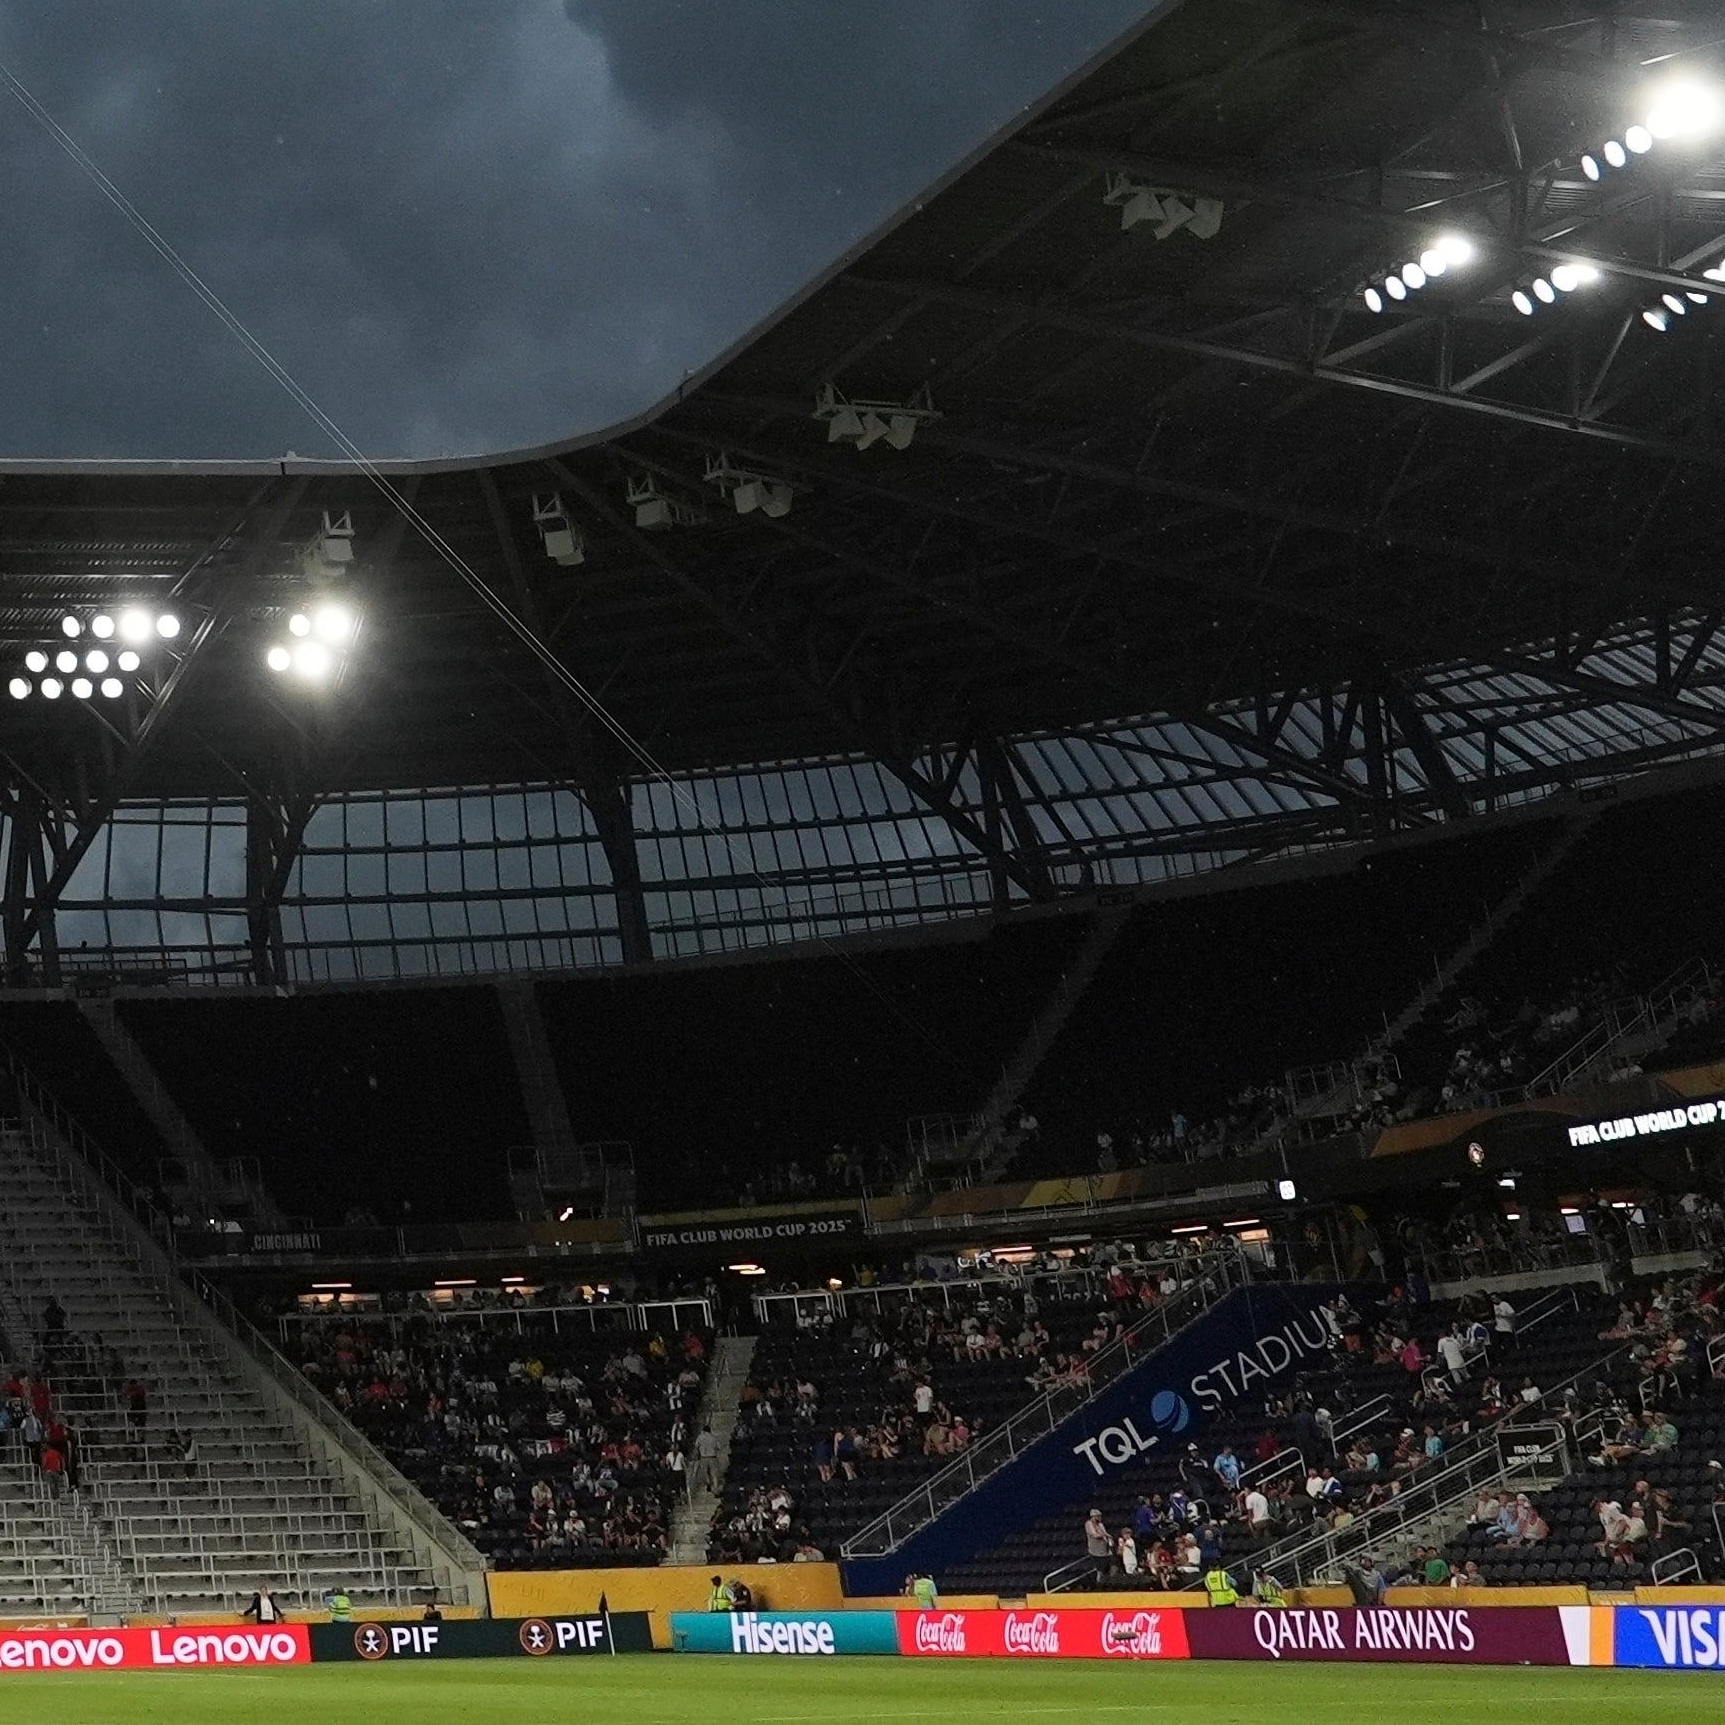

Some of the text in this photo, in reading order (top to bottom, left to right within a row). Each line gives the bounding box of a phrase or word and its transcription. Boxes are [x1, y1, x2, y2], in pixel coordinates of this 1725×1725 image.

[1568, 1125, 1601, 1146] FIFA
[1599, 1118, 1636, 1141] CLUB
[1634, 1108, 1688, 1135] WORLD
[1687, 1103, 1718, 1125] CUP
[647, 1233, 677, 1247] FIFA
[680, 1230, 718, 1244] CLUB
[719, 1226, 773, 1241] WORLD
[776, 1223, 806, 1236] CUP
[1073, 1417, 1160, 1475] TQL
[150, 1630, 296, 1664] Lenovo
[390, 1626, 439, 1653] PIF
[555, 1620, 603, 1648] PIF
[730, 1612, 835, 1654] Hisense
[1254, 1609, 1475, 1658] QATAR AIRWAYS
[1638, 1609, 1725, 1666] VIS
